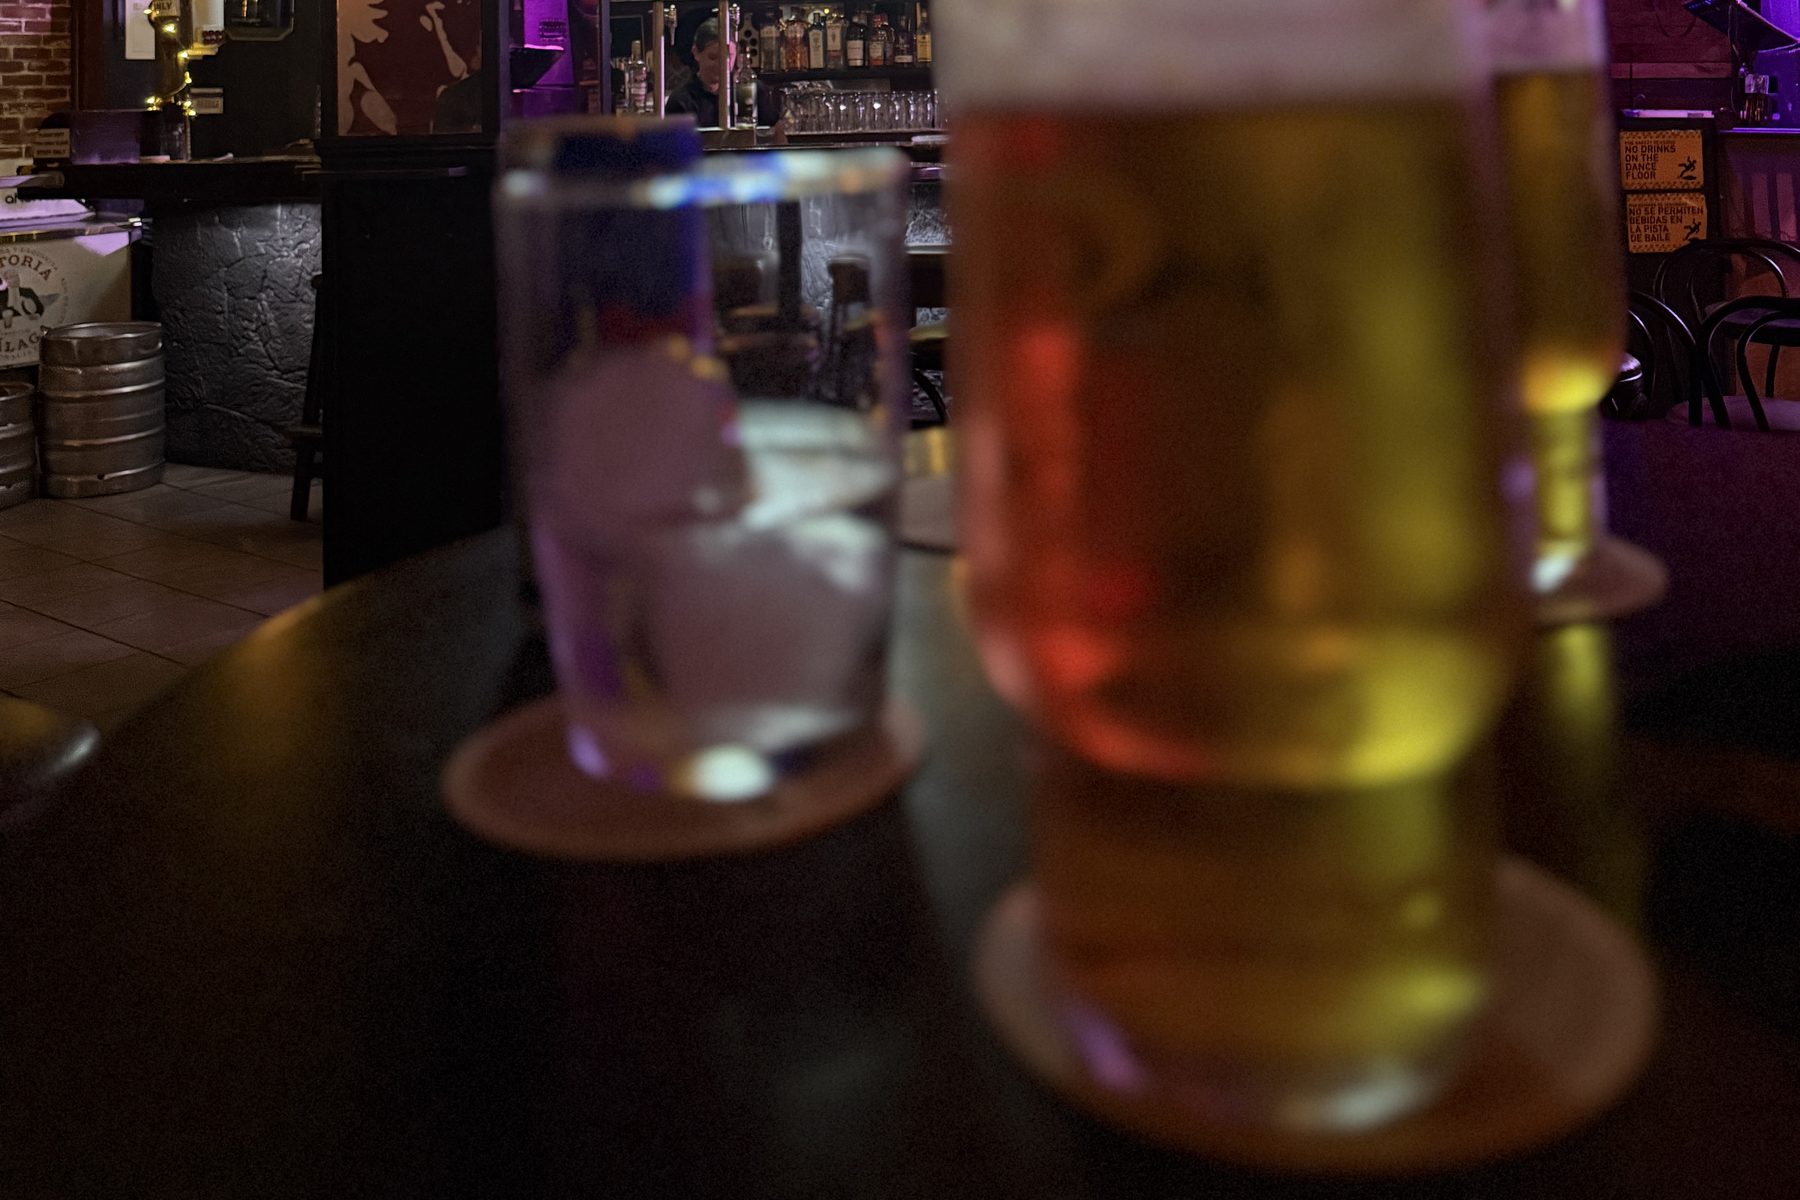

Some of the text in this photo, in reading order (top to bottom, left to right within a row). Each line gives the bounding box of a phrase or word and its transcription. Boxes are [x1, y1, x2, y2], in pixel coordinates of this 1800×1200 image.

[1625, 145, 1676, 153] NO DRINKS
[1625, 153, 1658, 162] ON THE
[1625, 163, 1657, 171] DANCE
[1626, 171, 1656, 180] FLOOR
[1629, 206, 1704, 215] NO SE PERMITEN
[1629, 216, 1683, 224] BEBIDAS EN
[1630, 225, 1669, 233] LA PISTA
[1630, 233, 1670, 242] DE BAILE
